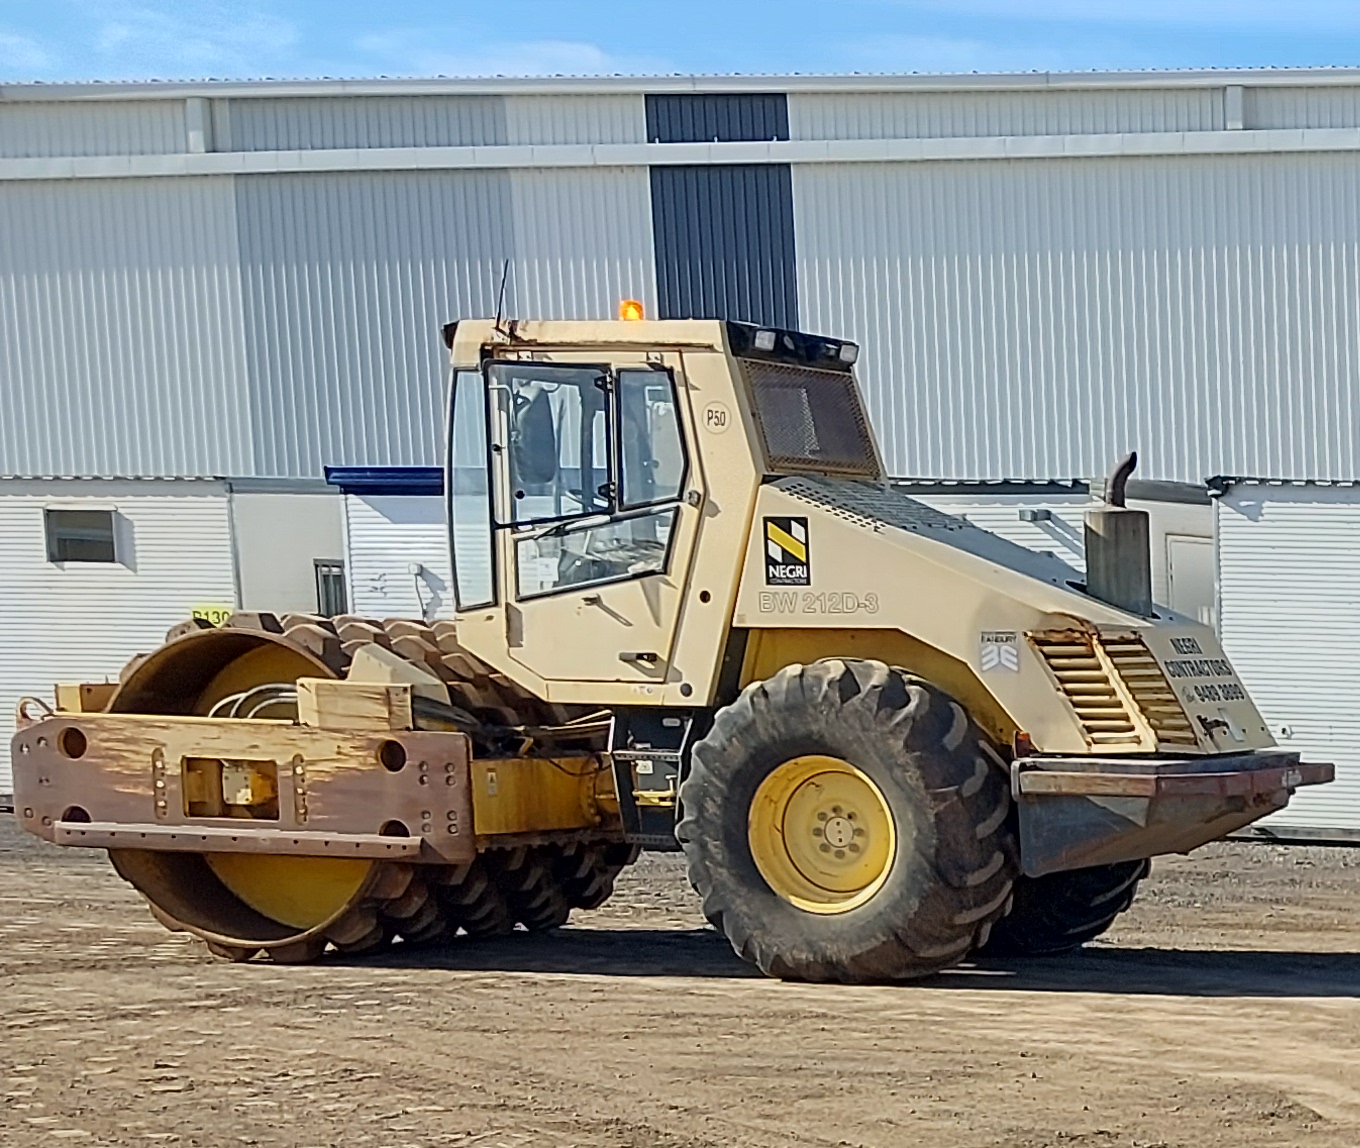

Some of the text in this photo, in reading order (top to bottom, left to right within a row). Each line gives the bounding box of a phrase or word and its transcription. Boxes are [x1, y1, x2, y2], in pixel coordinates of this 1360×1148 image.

[768, 564, 808, 578] NEGRI
[758, 591, 880, 614] BW 212D-3
[1163, 658, 1233, 678] CONTRACTORS
